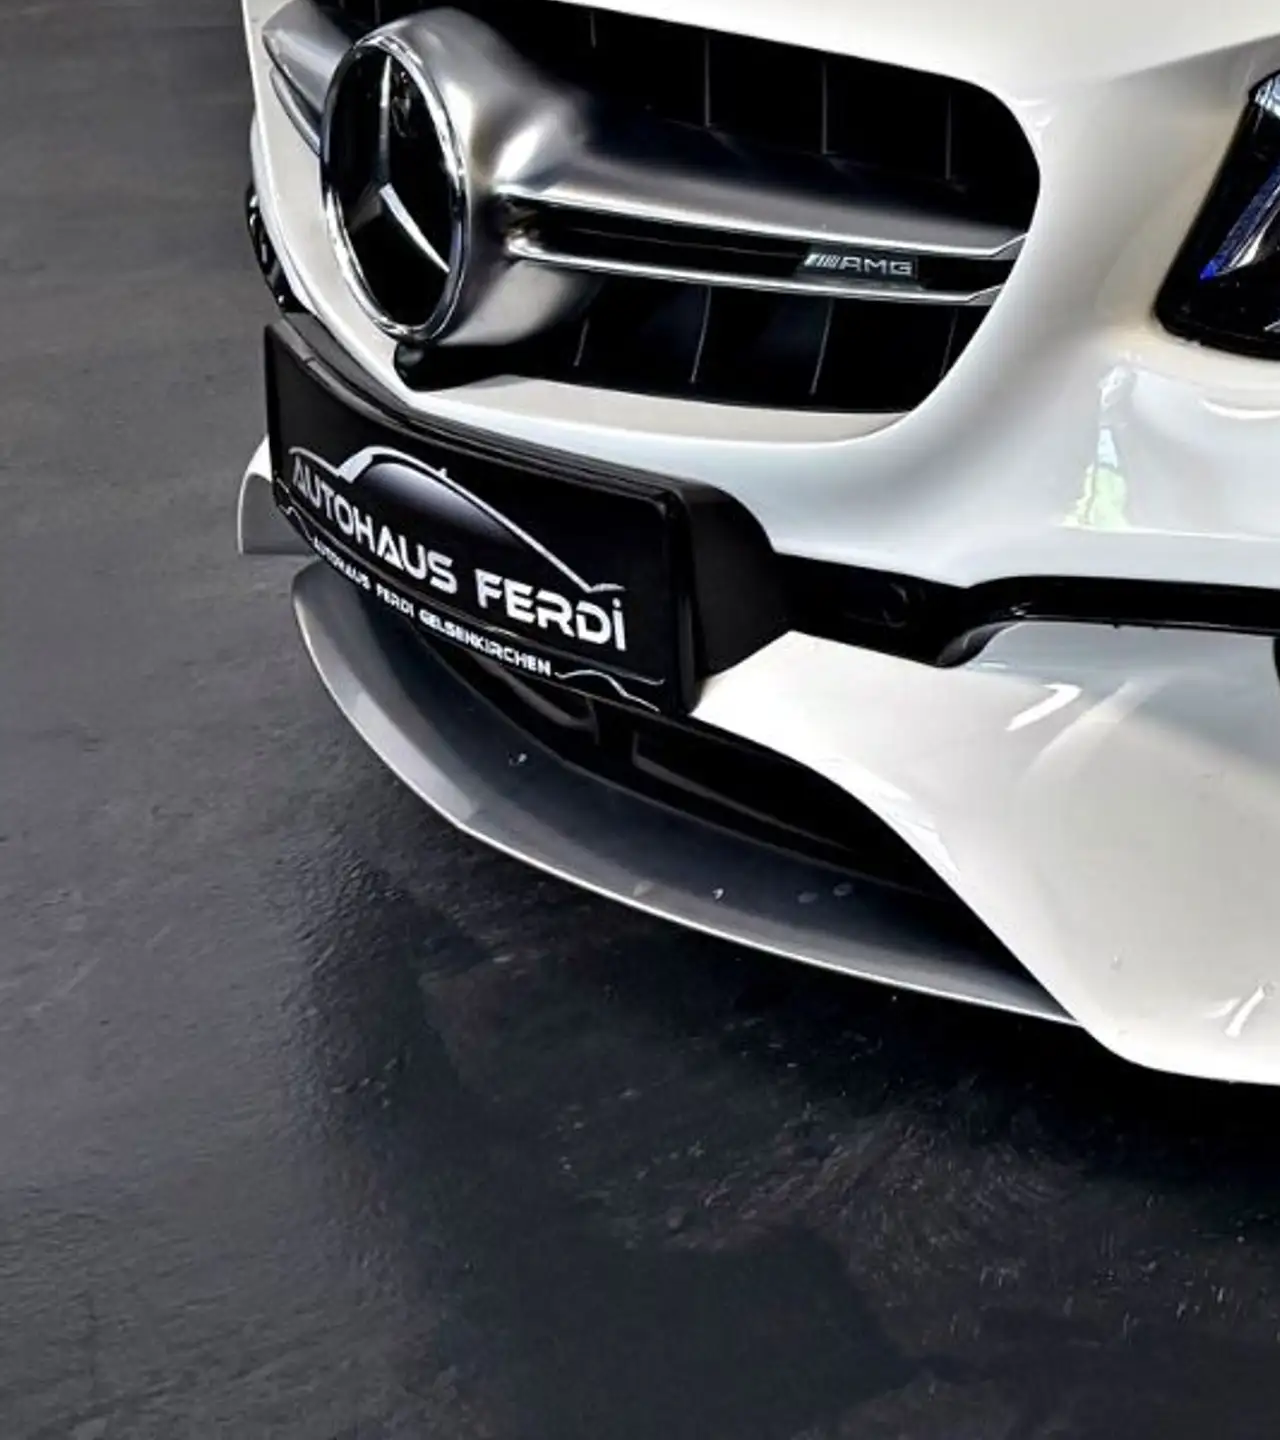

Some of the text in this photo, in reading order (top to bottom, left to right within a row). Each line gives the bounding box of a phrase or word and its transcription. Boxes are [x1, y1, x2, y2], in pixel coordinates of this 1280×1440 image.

[291, 455, 458, 595] AUTOHAUS
[313, 536, 372, 590] AUTOHAUS
[418, 608, 552, 677] GELSENKIRCHEN
